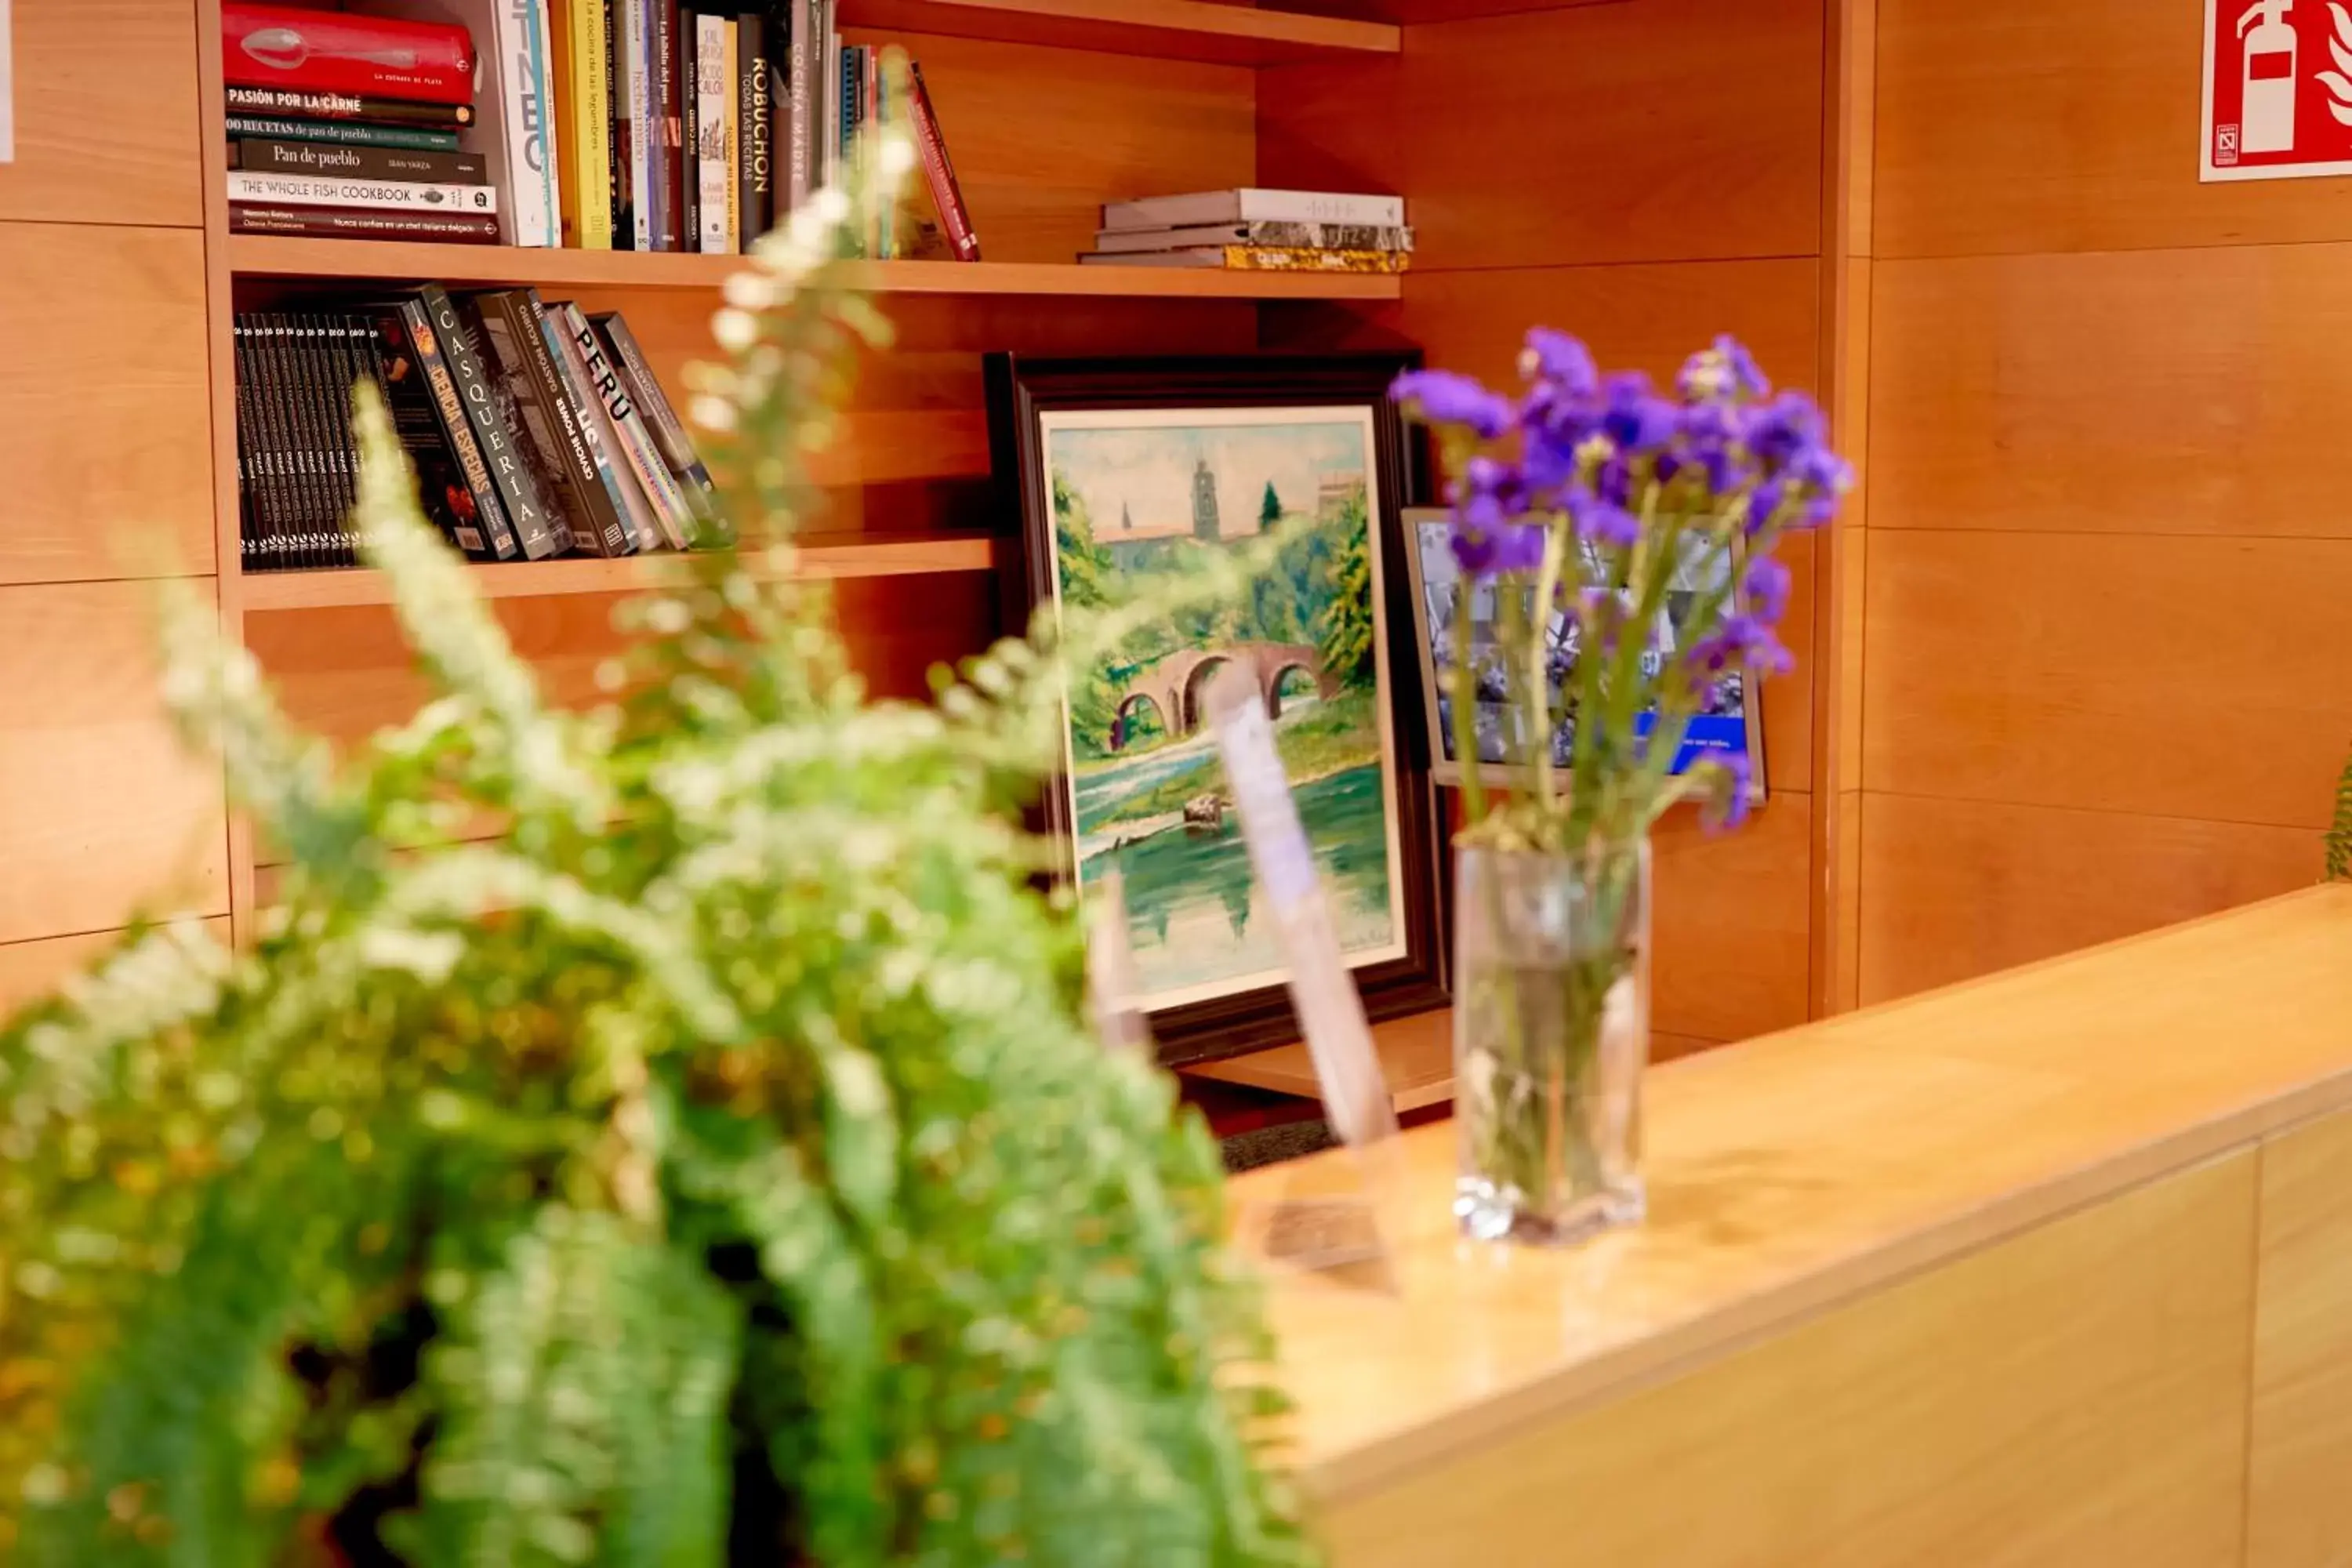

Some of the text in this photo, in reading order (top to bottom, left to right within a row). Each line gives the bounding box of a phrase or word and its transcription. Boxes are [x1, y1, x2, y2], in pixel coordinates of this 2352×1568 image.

[586, 17, 596, 54] cocina
[659, 35, 669, 65] biblia
[589, 57, 597, 68] de
[660, 67, 670, 83] del
[228, 89, 362, 112] PASIÓN POR LA CARNE
[659, 84, 668, 104] pan
[791, 43, 804, 182] COCINA MADRE
[242, 119, 295, 134] RECETAS
[295, 123, 307, 136] de
[307, 127, 326, 139] pan
[327, 125, 339, 138] de
[340, 128, 372, 143] pueblo
[589, 93, 599, 150] legumbres
[742, 73, 753, 181] TODAS LAS RECETAS
[752, 57, 769, 193] ROBUCHON
[273, 144, 361, 169] Pan de pueblo
[241, 179, 412, 202] THE WHOLE FISH COOKBOOK
[518, 303, 539, 347] ACURIO
[535, 346, 558, 394] GASTÓN
[576, 328, 633, 421] PERÚ
[430, 363, 464, 425] CIENCIA
[453, 428, 491, 494] ESPECIAS
[555, 397, 576, 437] POWER
[570, 435, 594, 481] CEVICHE
